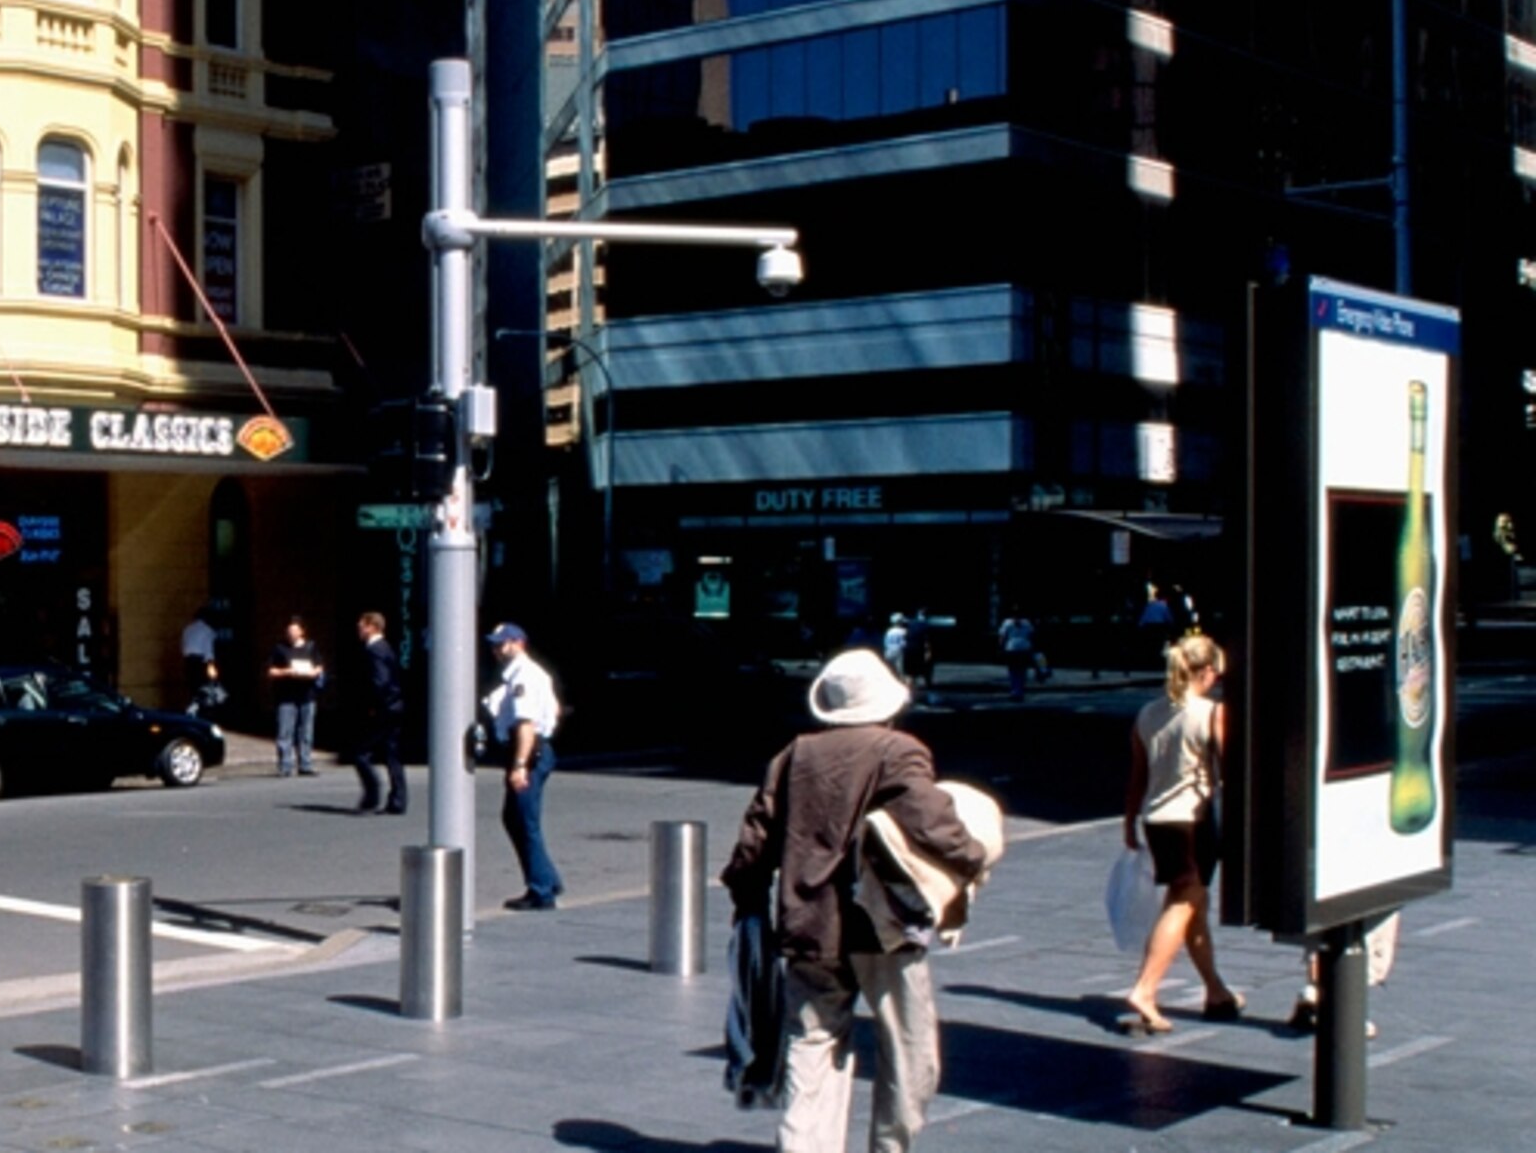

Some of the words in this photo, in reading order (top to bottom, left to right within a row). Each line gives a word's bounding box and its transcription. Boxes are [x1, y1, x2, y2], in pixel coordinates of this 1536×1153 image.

[90, 409, 234, 455] CLASSICS
[756, 490, 815, 511] DUTY
[822, 487, 882, 509] FREE
[76, 587, 92, 667] SAL
